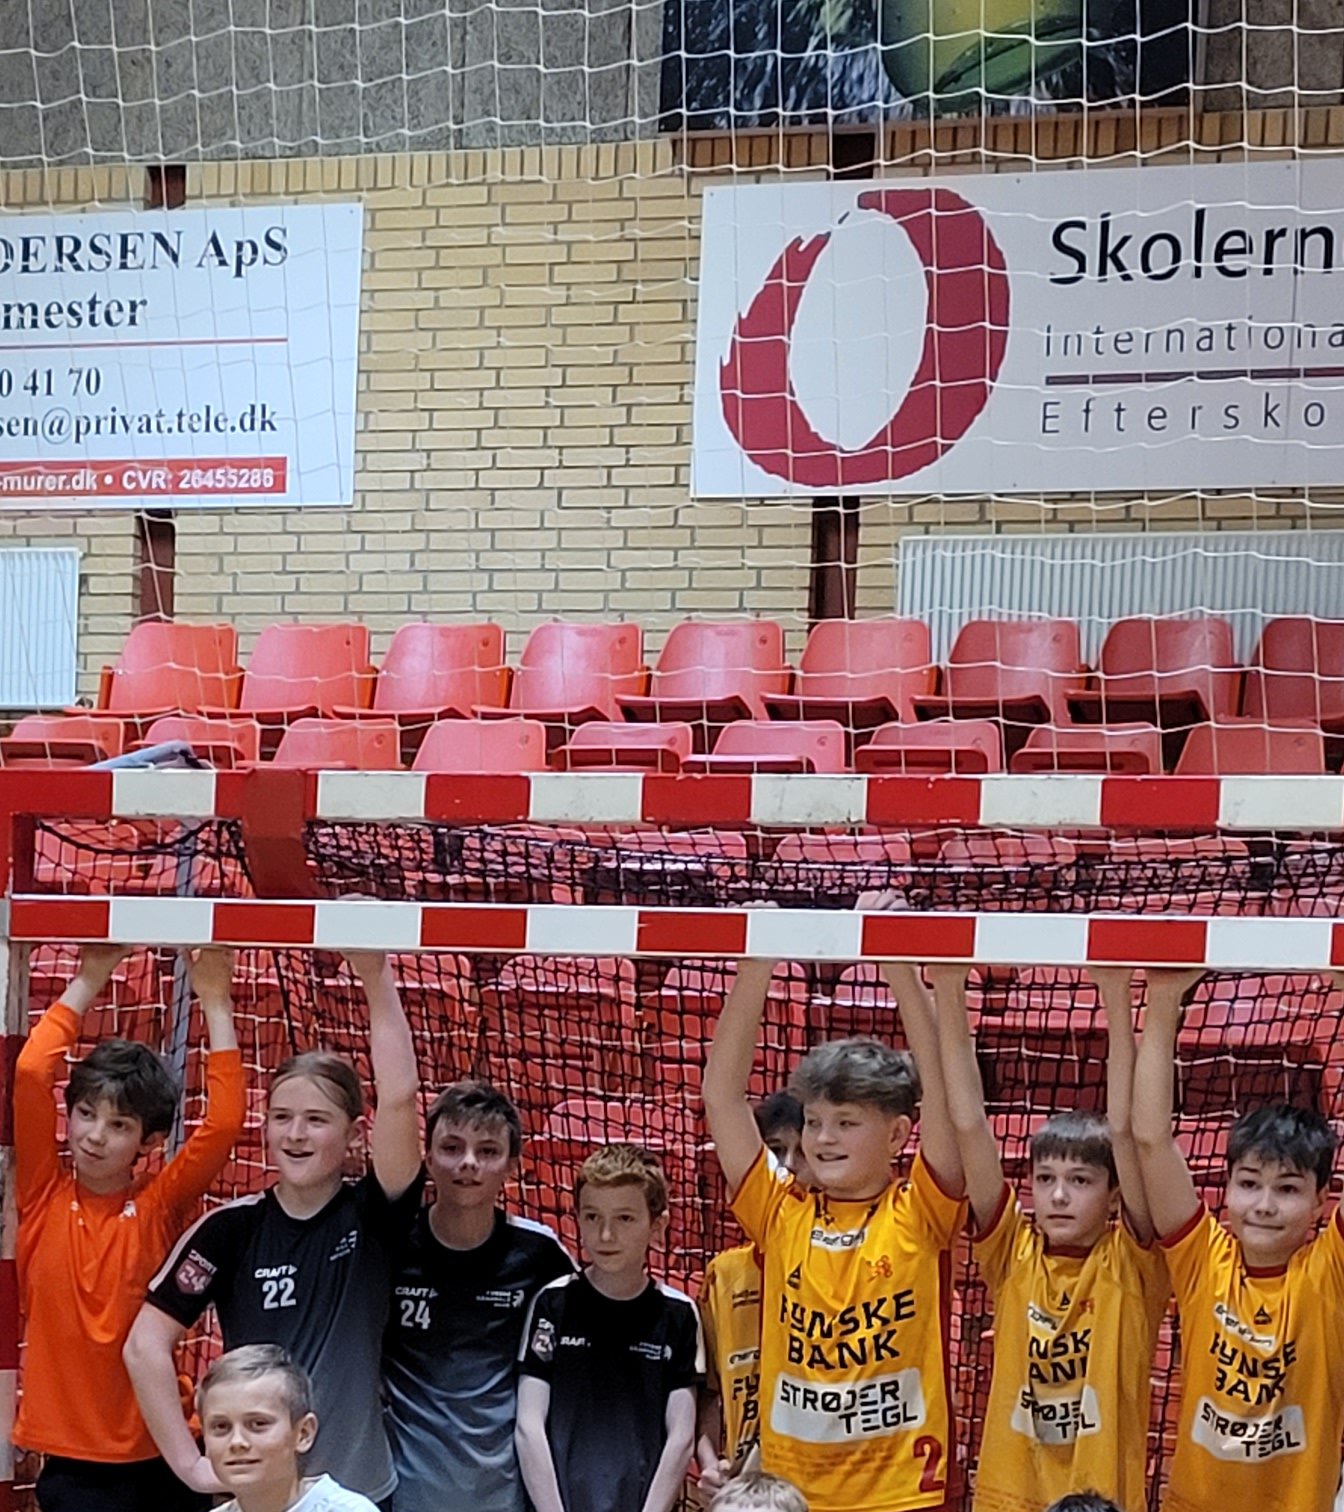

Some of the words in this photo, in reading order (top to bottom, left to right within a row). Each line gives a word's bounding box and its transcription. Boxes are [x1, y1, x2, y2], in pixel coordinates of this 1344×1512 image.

[196, 226, 289, 278] ApS
[23, 368, 54, 397] 41
[68, 367, 101, 396] 70
[122, 470, 173, 490] CVR:
[262, 1277, 297, 1310] 22
[400, 1300, 431, 1330] 24
[787, 1329, 901, 1371] BANK
[1028, 1328, 1092, 1360] NSK
[779, 1379, 900, 1413] STRØJER
[838, 1401, 918, 1433] TEGL
[1240, 1431, 1301, 1458] TEGL
[913, 1435, 945, 1493] 2
